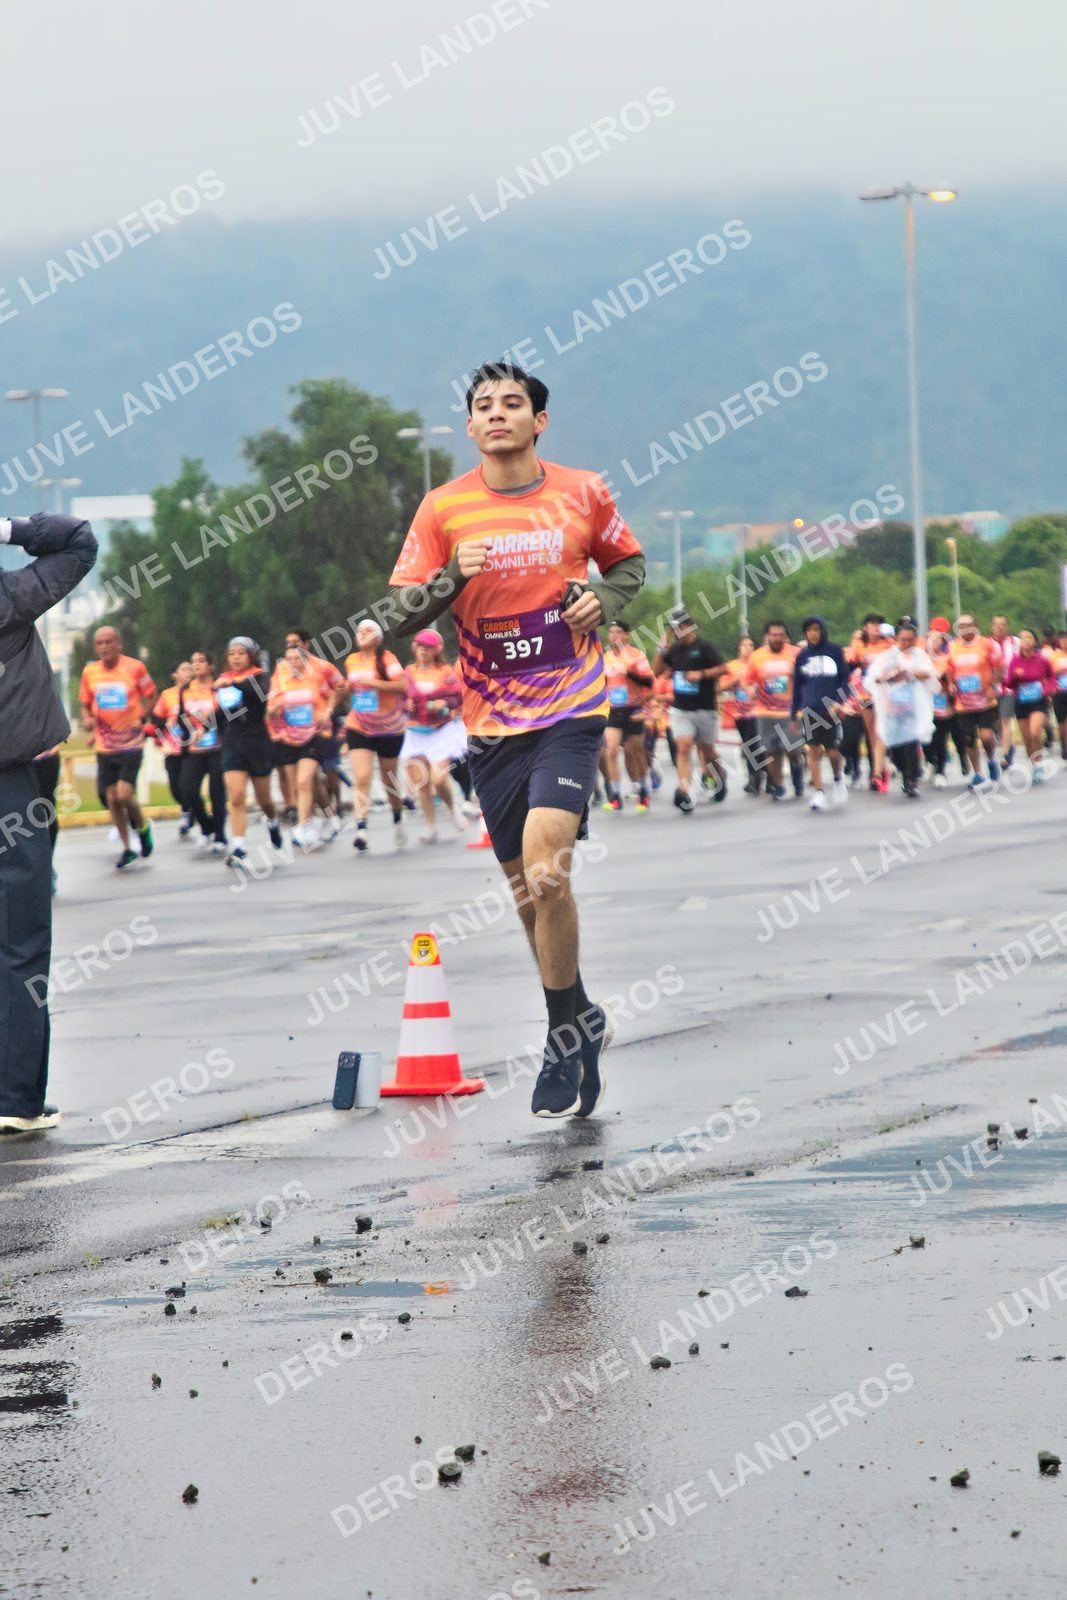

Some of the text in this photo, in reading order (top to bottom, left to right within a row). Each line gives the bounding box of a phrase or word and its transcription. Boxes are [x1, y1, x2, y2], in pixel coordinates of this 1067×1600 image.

[483, 552, 547, 572] OMNILIFE
[483, 619, 520, 632] CARRERA
[485, 631, 512, 639] OMNILIFE
[503, 636, 543, 659] 397
